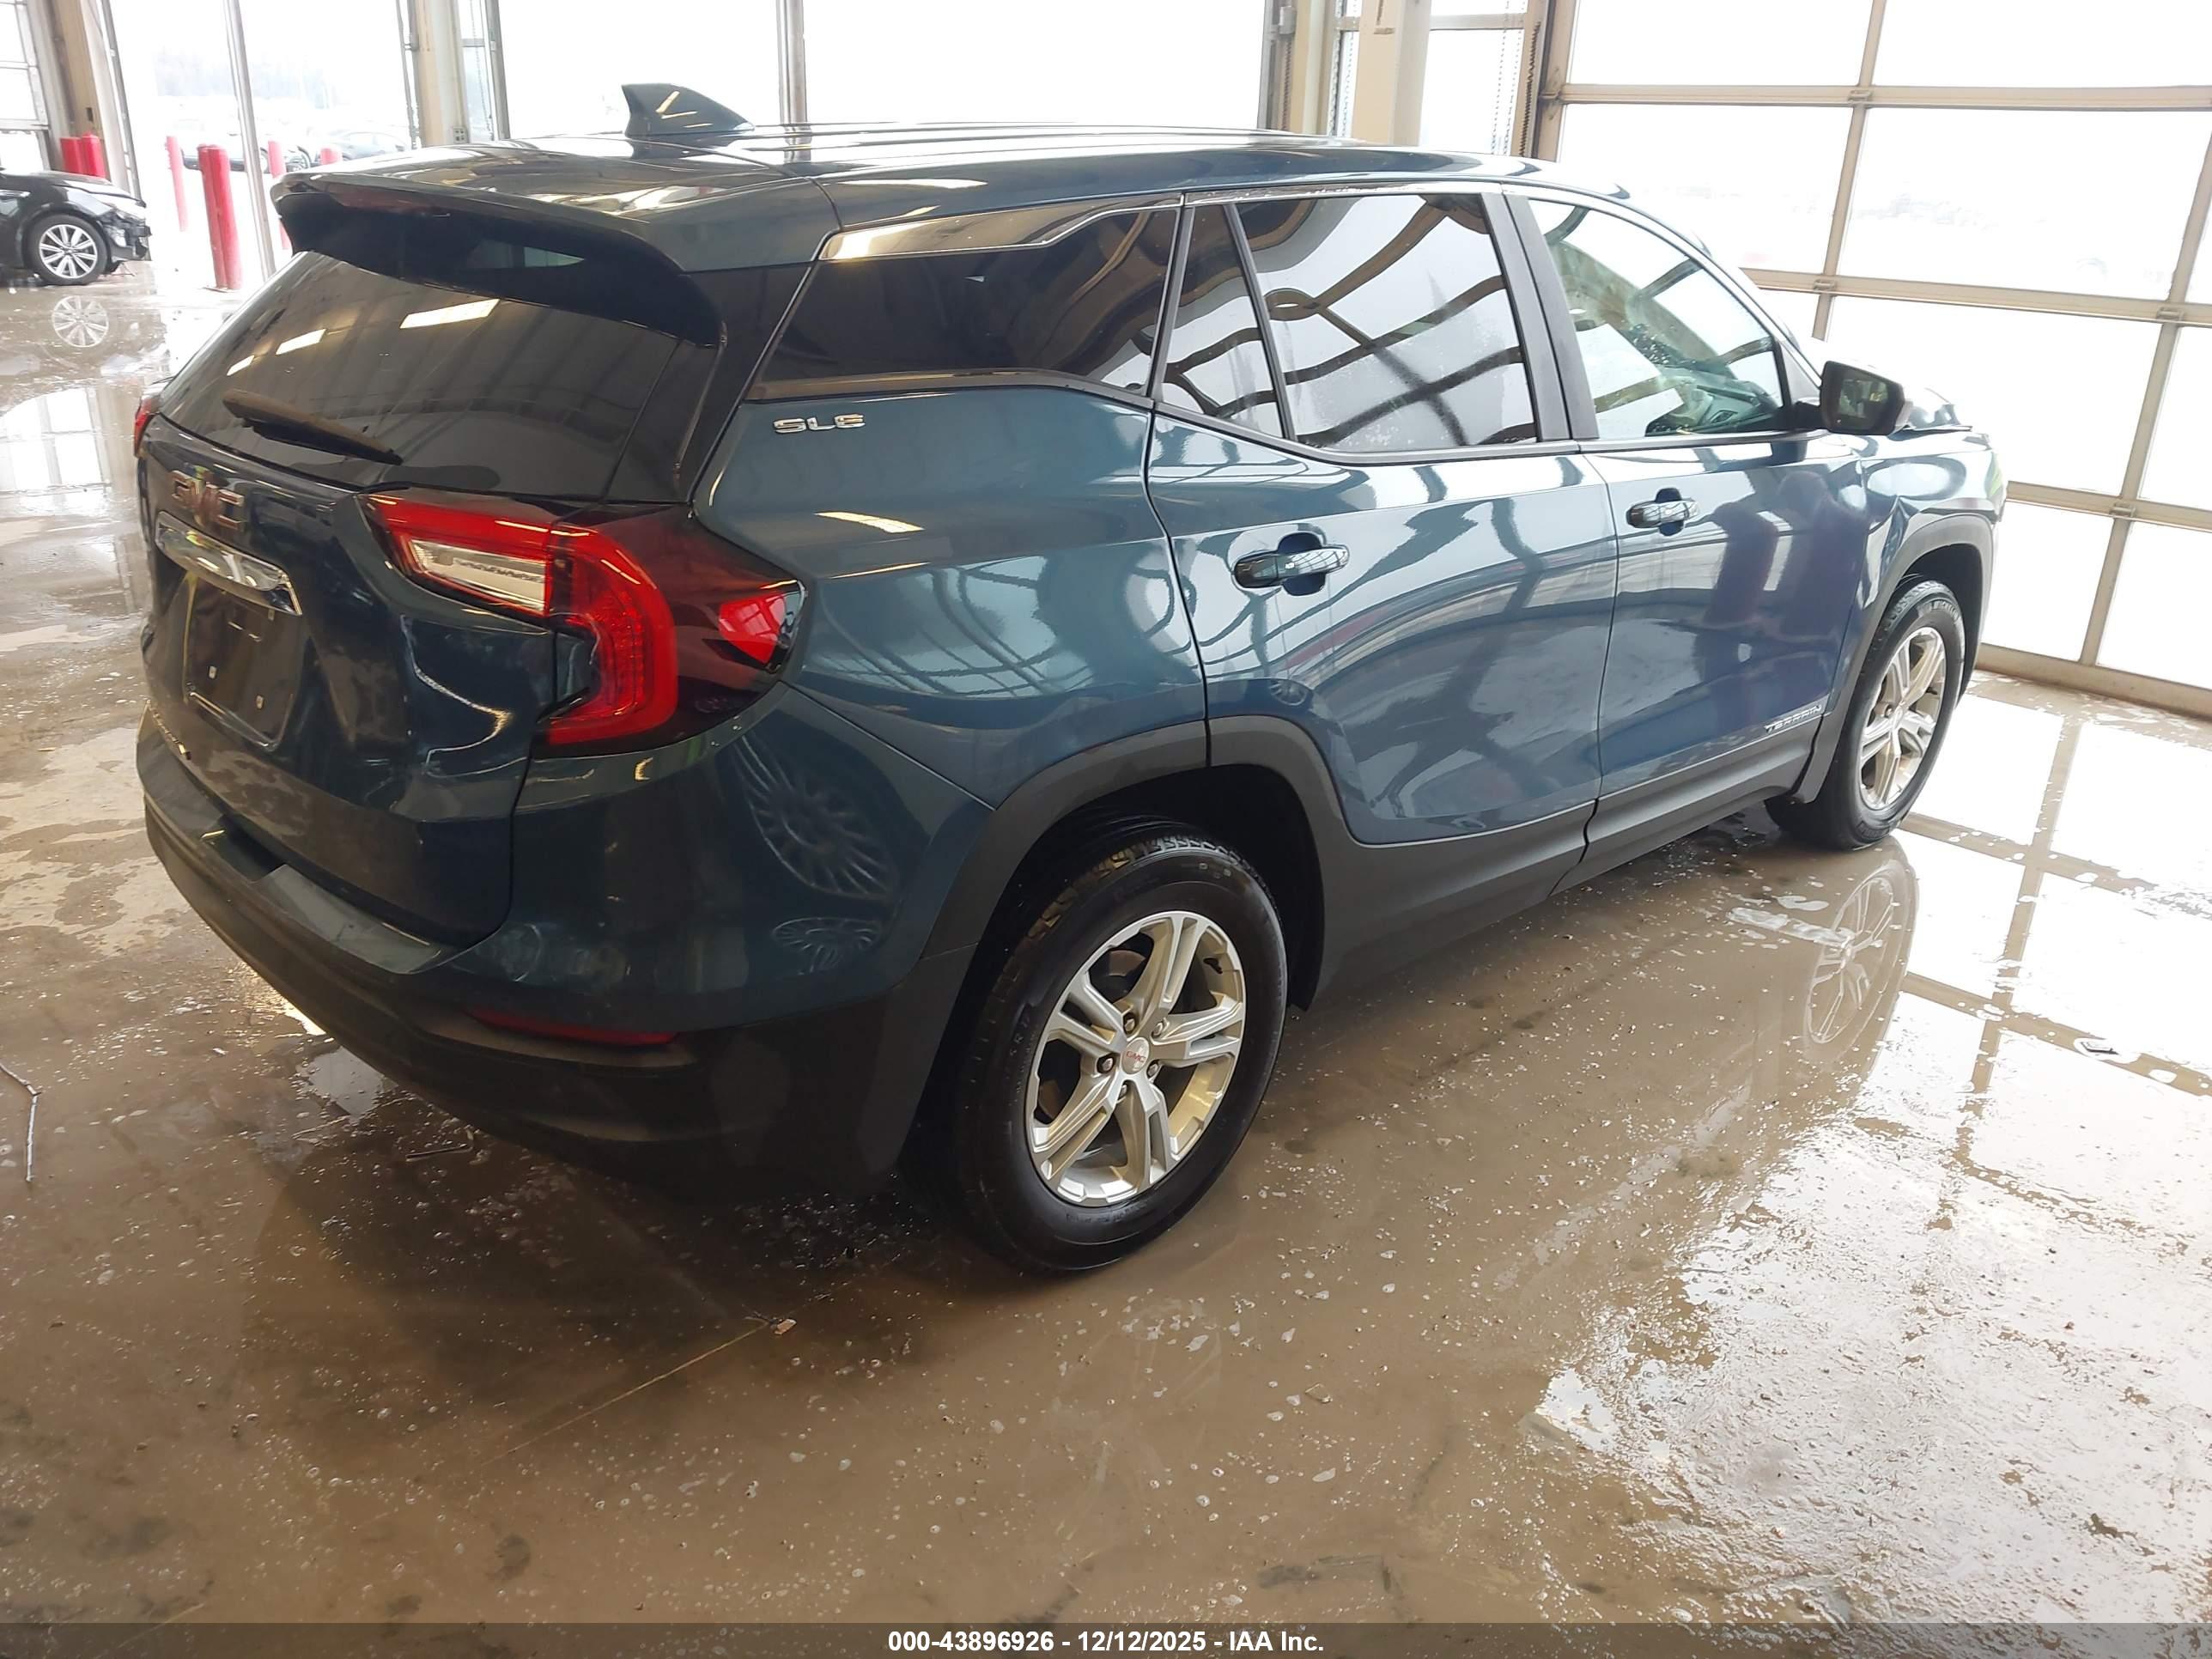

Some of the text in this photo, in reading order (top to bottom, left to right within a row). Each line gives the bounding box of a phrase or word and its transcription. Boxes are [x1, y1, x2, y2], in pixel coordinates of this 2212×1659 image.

[773, 414, 866, 433] SLE
[171, 469, 245, 531] GMC
[1126, 1050, 1146, 1064] GMC
